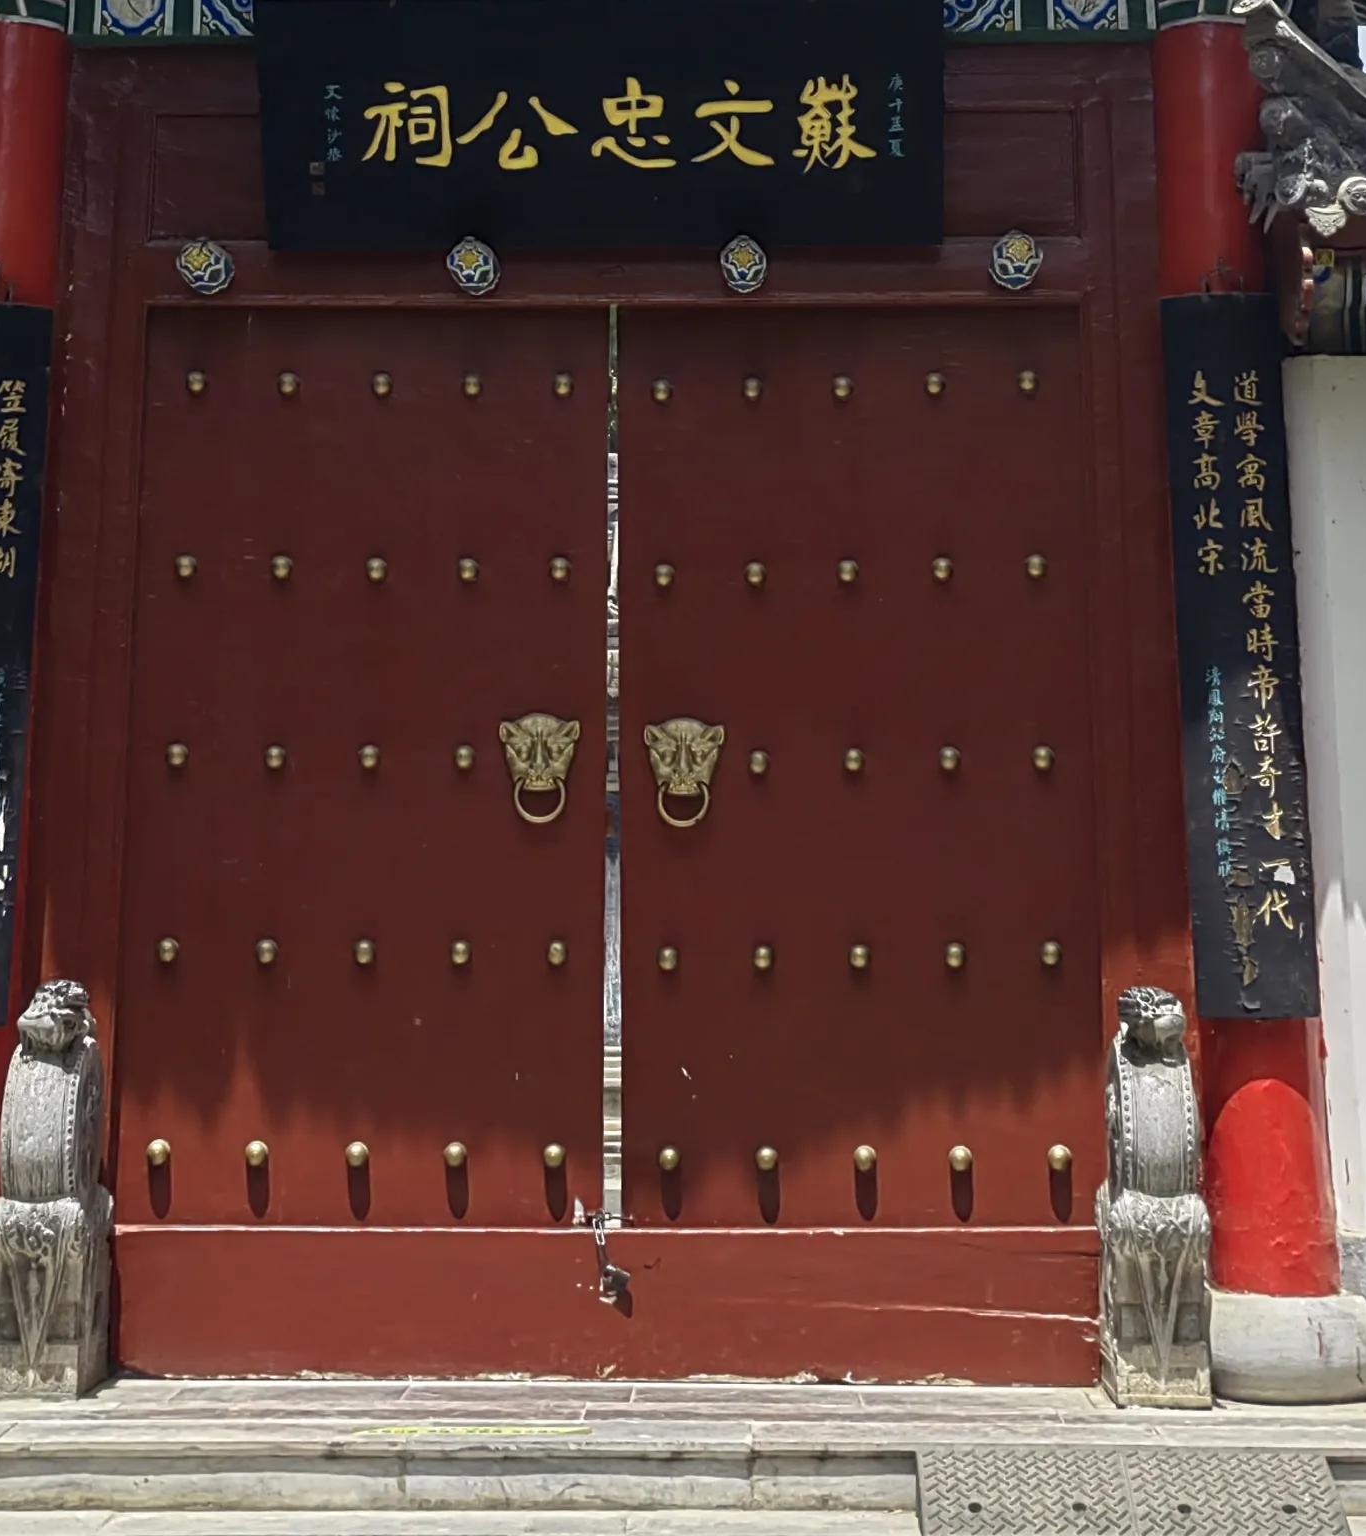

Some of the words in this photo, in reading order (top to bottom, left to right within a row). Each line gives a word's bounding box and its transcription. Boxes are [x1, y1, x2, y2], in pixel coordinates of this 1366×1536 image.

[361, 73, 877, 174] 蘇文忠公祠
